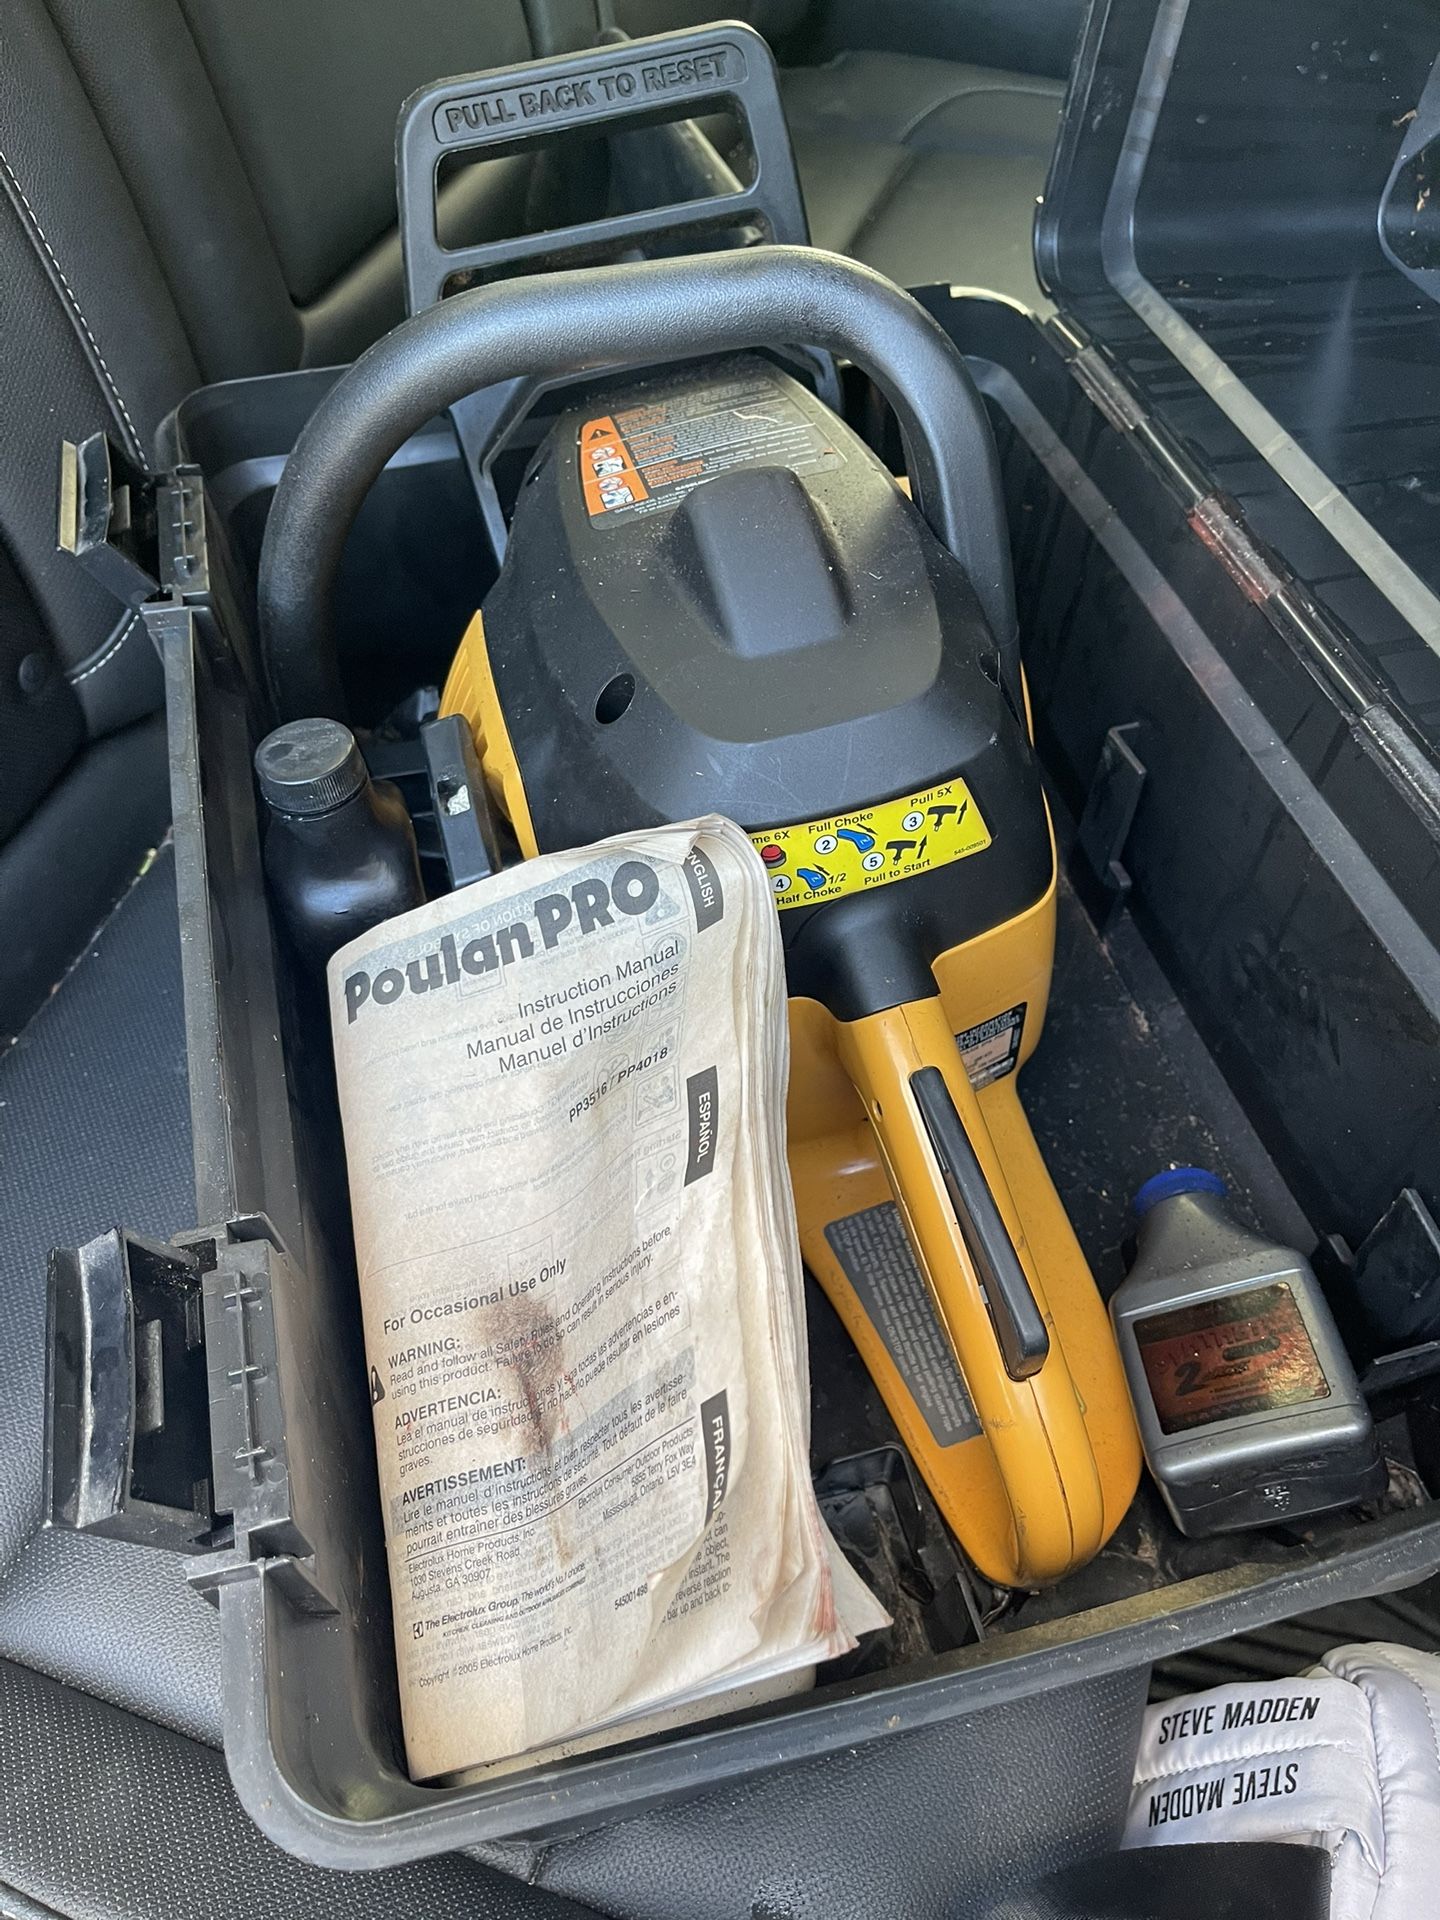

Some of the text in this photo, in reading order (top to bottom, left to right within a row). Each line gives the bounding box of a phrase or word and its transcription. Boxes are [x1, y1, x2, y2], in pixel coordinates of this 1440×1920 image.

[446, 51, 728, 133] PULL BACK TO RESET
[911, 785, 953, 807] Pull 5X
[774, 830, 791, 841] 6X
[808, 812, 874, 835] Full Choke
[909, 816, 918, 828] 3
[821, 839, 831, 852] 2
[869, 856, 878, 868] 5
[775, 878, 785, 889] 4
[829, 873, 847, 884] 1/2
[864, 859, 931, 886] Pull to Start
[776, 886, 842, 906] Half Choke
[519, 940, 680, 1019] Instruction Manual
[466, 1023, 535, 1059] Manual
[541, 1013, 564, 1035] de
[568, 963, 680, 1024] Instrucciones
[499, 1036, 568, 1074] Manuel
[569, 1081, 608, 1123] PP3516
[617, 1046, 669, 1084] PP4018
[697, 1092, 713, 1163] ESPAÑOL
[383, 1257, 567, 1335] For Occasional Use Only
[390, 1225, 671, 1387] Read and follow all Safety and Operating before
[391, 1252, 654, 1401] using this product. so can result serious injury.
[388, 1337, 461, 1369] WARNING:
[396, 1290, 680, 1447] Lea el manual de todas advertencias en-
[398, 1304, 681, 1461] strucciones de no puede resultar en lesiones
[395, 1388, 502, 1430] ADVERTENCIA:
[399, 1455, 433, 1478] graves.
[404, 1374, 687, 1524] Lire le manuel et bien respecter tous les avertisse-
[405, 1388, 688, 1540] ments et toutes les instructions de Tout défaut de faire
[578, 1426, 694, 1510] Electrolux Consumer Outdoor Products
[648, 1459, 663, 1477] Terry
[664, 1451, 678, 1466] Fox
[679, 1441, 695, 1459] Way
[712, 1415, 725, 1510] FRANÇAI
[402, 1457, 527, 1506] AVERTISSEMENT:
[639, 1454, 697, 1498] Ontario L5V 3E4
[406, 1473, 589, 1558] pourrait entraîner des blessures graves.
[714, 1522, 729, 1537] can
[408, 1544, 475, 1575] Electrolux Home
[410, 1546, 520, 1588] 1030 Stevens Creek Road
[445, 1568, 492, 1589] GA 30907
[716, 1551, 731, 1565] The
[667, 1586, 722, 1621] bar up and back
[675, 1566, 732, 1601] reverse reaction
[425, 1619, 445, 1631] The
[441, 1606, 487, 1626] Electrolux
[521, 1590, 534, 1601] The
[419, 1642, 540, 1689] Copyright Electrolux Home
[1158, 1697, 1321, 1745] STEVE MADDEN
[1148, 1763, 1299, 1828] STEVE MADDEN
